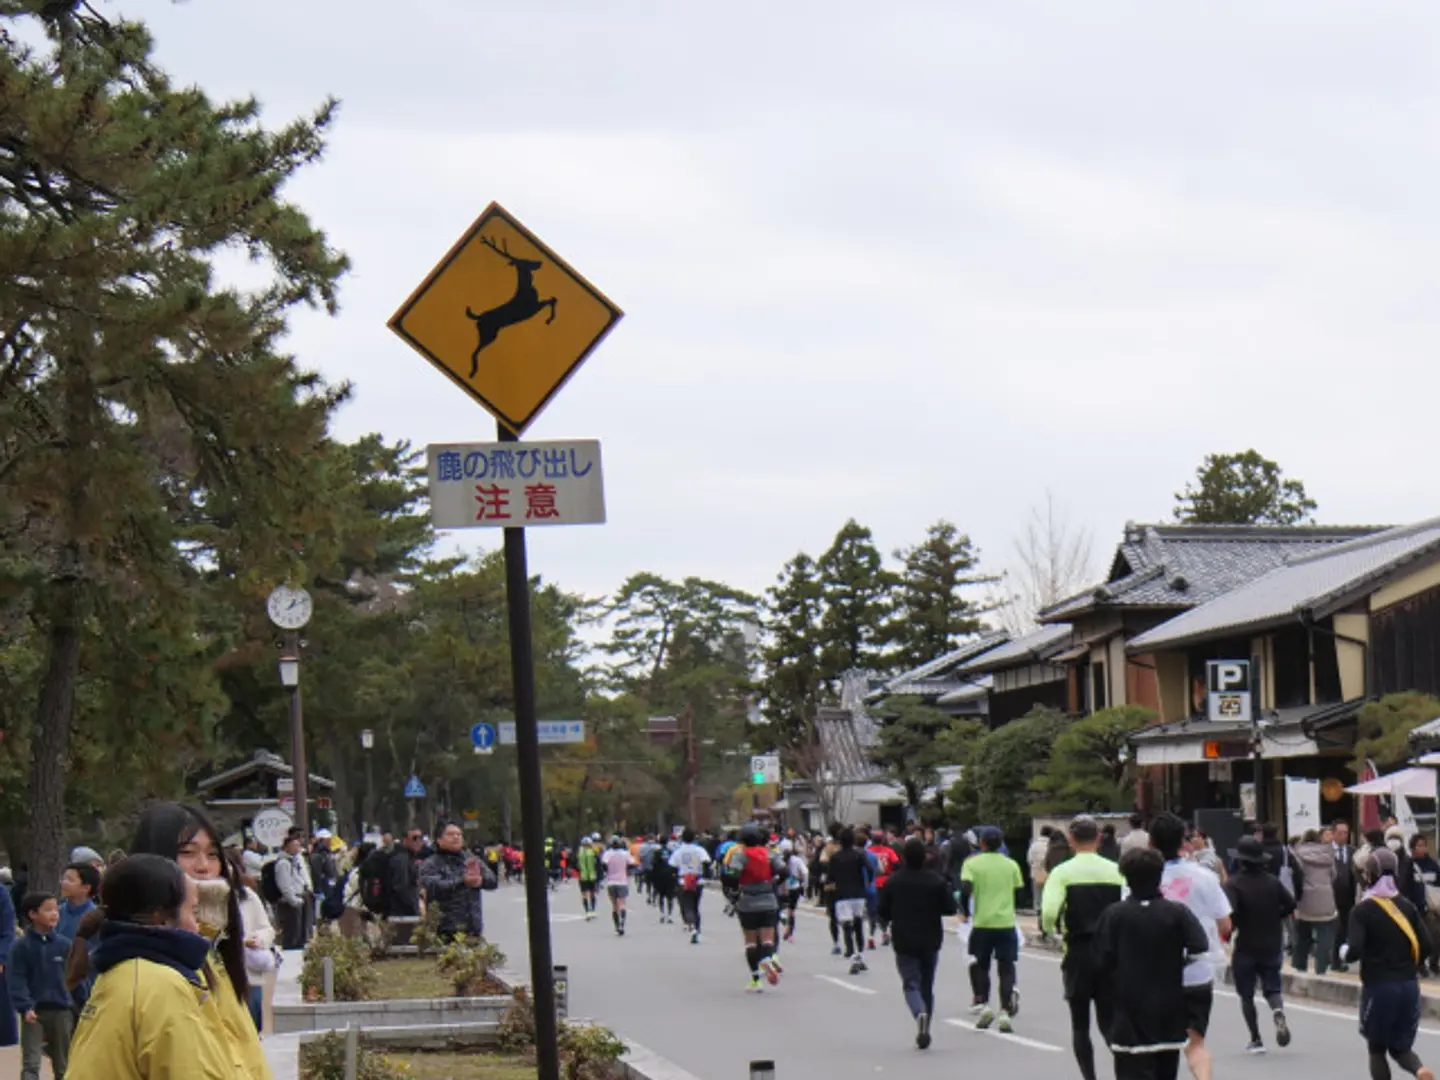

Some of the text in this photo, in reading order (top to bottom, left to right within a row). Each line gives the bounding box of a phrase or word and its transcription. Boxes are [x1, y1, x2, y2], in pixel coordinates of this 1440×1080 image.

[437, 449, 592, 482] 鹿の飛び出し
[475, 483, 559, 520] 注意
[1218, 664, 1242, 691] P
